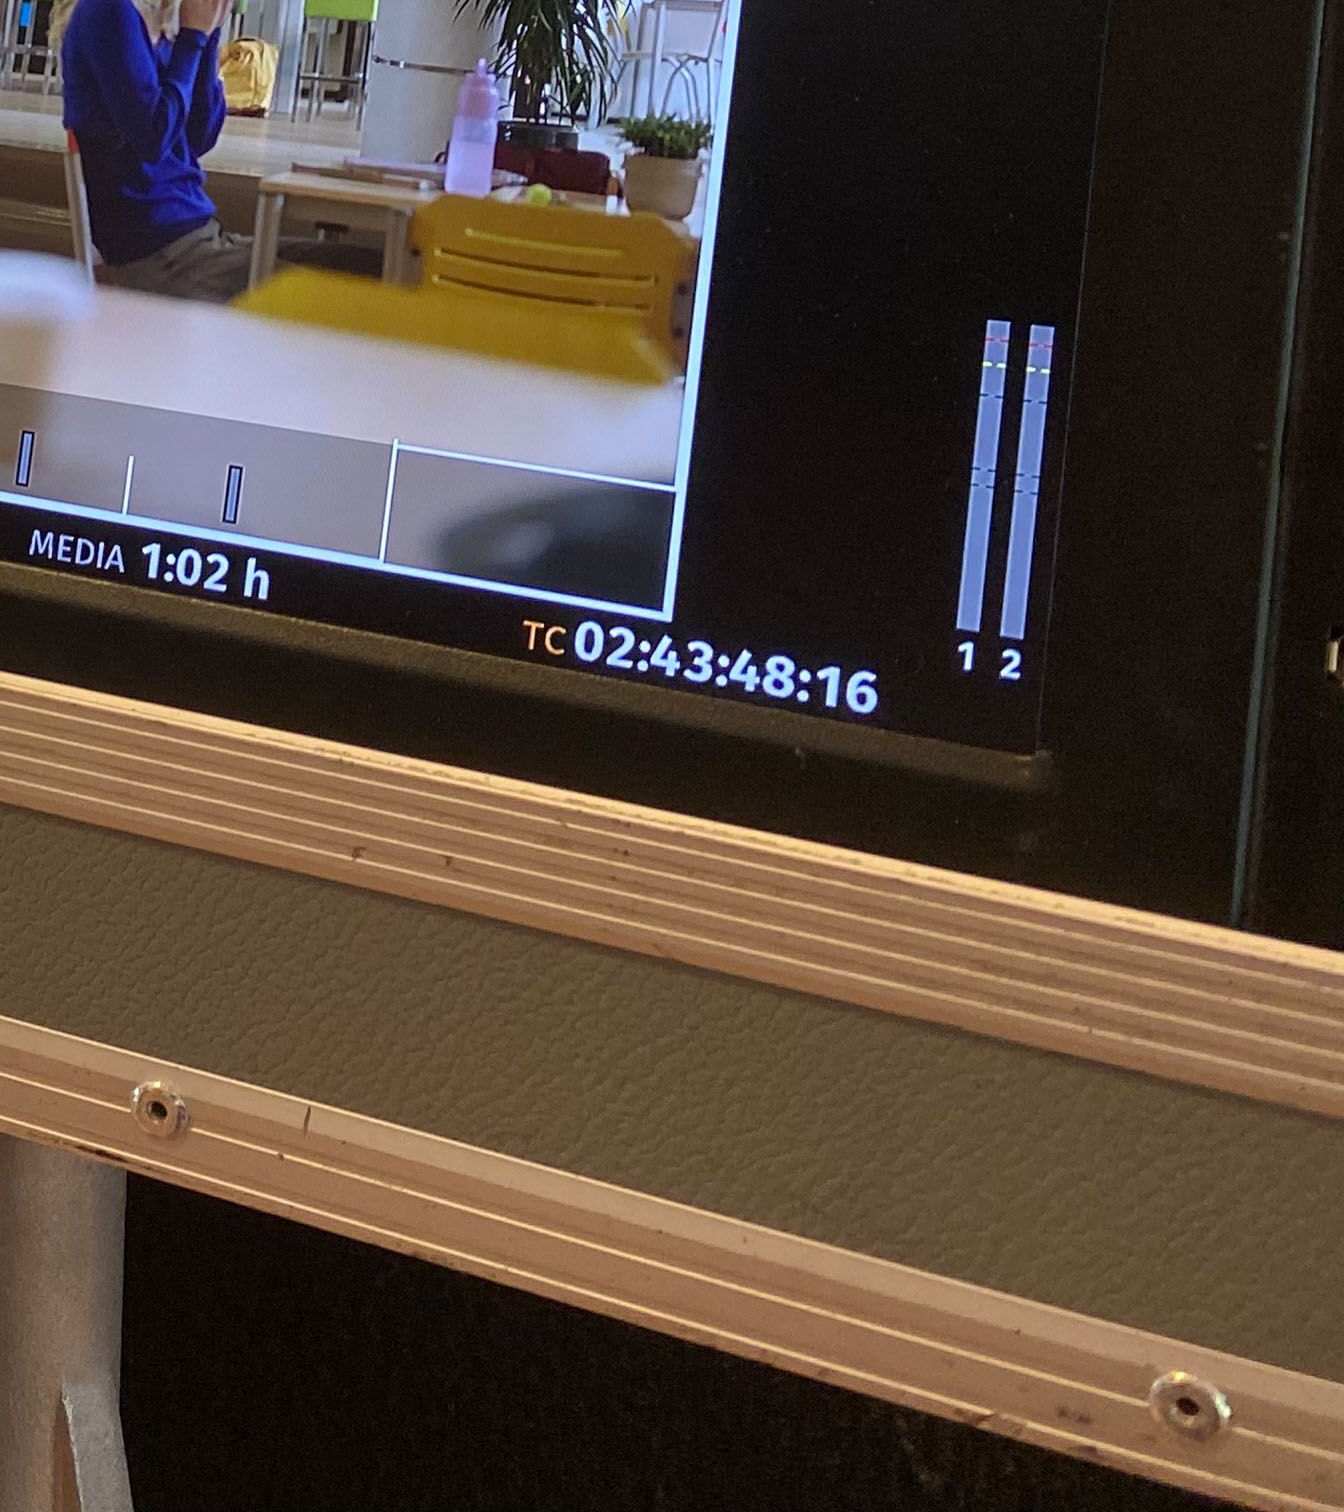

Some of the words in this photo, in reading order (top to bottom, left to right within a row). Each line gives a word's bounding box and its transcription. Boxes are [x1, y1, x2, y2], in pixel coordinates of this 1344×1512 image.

[29, 529, 126, 573] MEDIA
[141, 542, 228, 593] 1:02
[243, 556, 272, 601] h
[522, 620, 567, 656] TC
[573, 620, 880, 716] 02:43:48:16
[957, 641, 977, 673] 1
[999, 649, 1024, 681] 2
